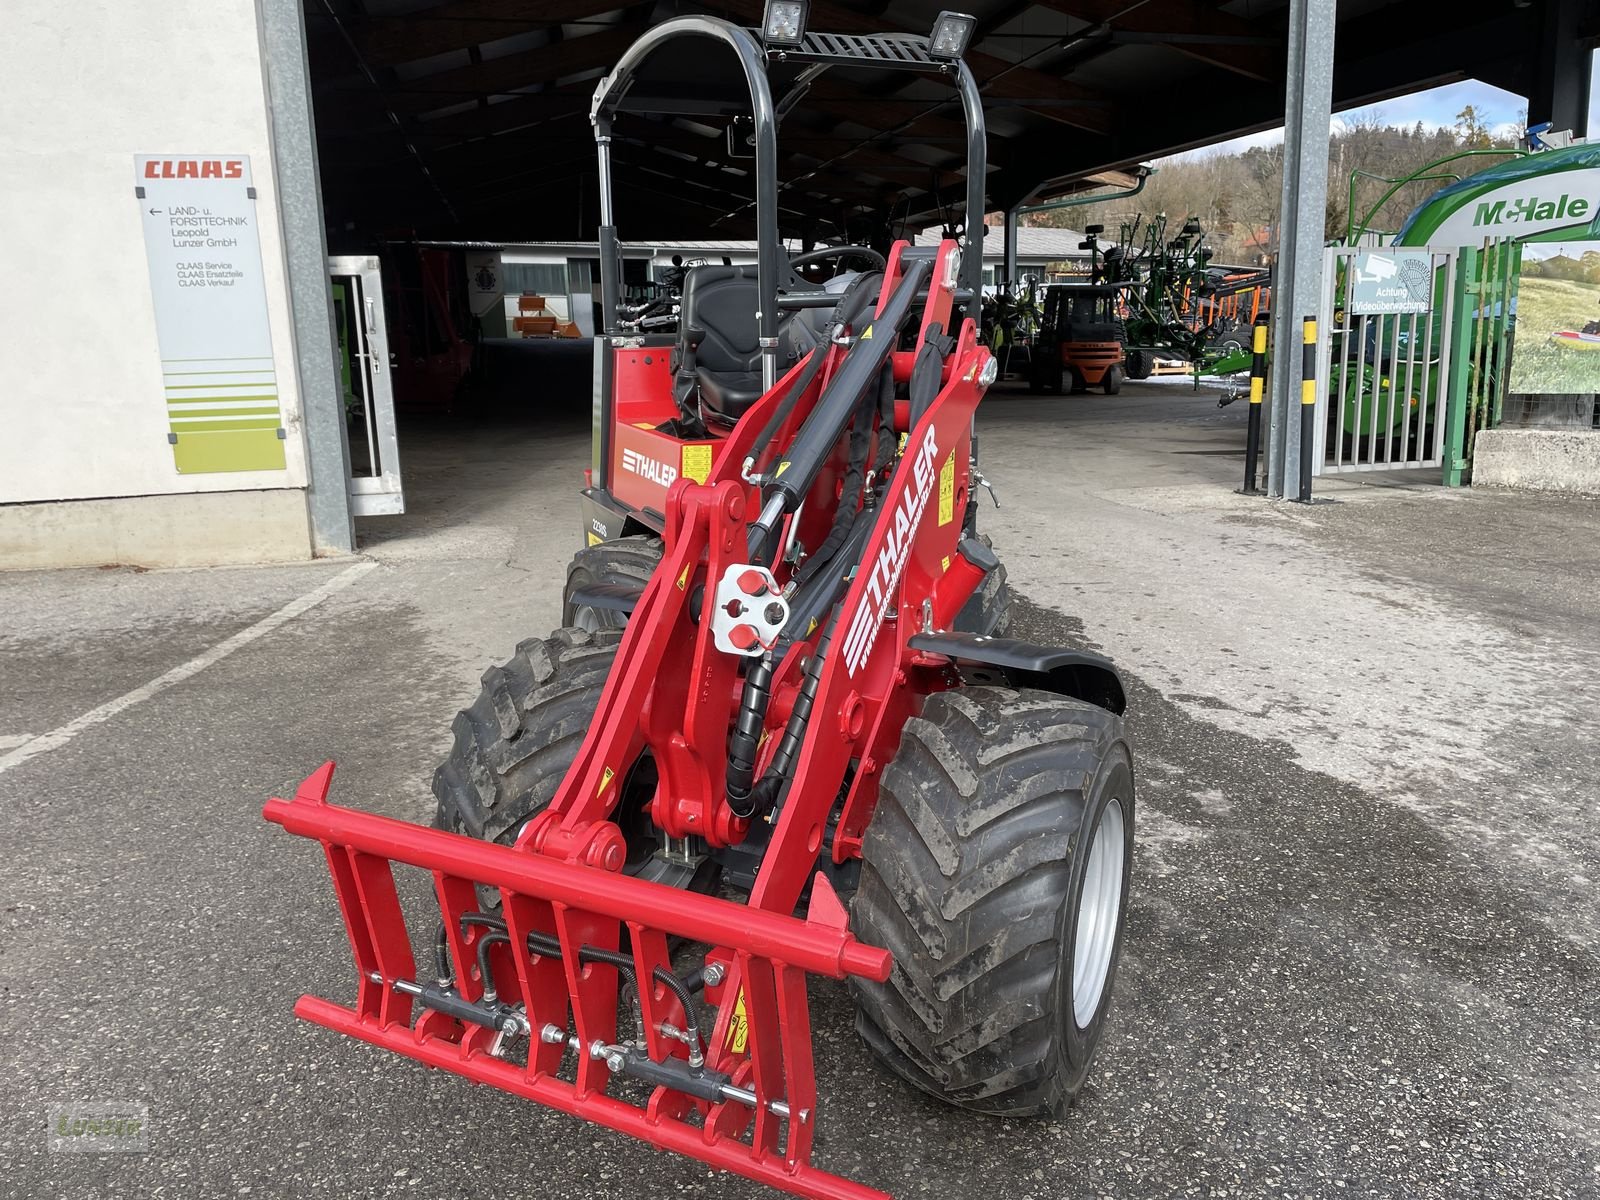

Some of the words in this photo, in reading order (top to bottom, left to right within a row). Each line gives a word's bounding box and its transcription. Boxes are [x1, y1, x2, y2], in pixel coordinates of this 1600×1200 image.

[144, 160, 243, 179] CLAAS
[168, 206, 200, 216] LAND-
[203, 208, 212, 216] u.
[1472, 194, 1589, 227] McHale
[170, 217, 248, 226] FORSTTECHNIK
[171, 228, 209, 238] Leopold
[172, 239, 204, 248] Lunzer
[206, 238, 237, 247] GmbH
[176, 262, 203, 270] CLAAS
[205, 262, 232, 270] Service
[177, 271, 204, 279] CLAAS
[206, 270, 243, 278] Ersatzteile
[178, 279, 206, 287] CLAAS
[207, 279, 234, 287] Verkauf
[1376, 287, 1409, 299] Achtung
[1355, 300, 1426, 312] Videoüberwachung
[867, 423, 939, 609] THALER
